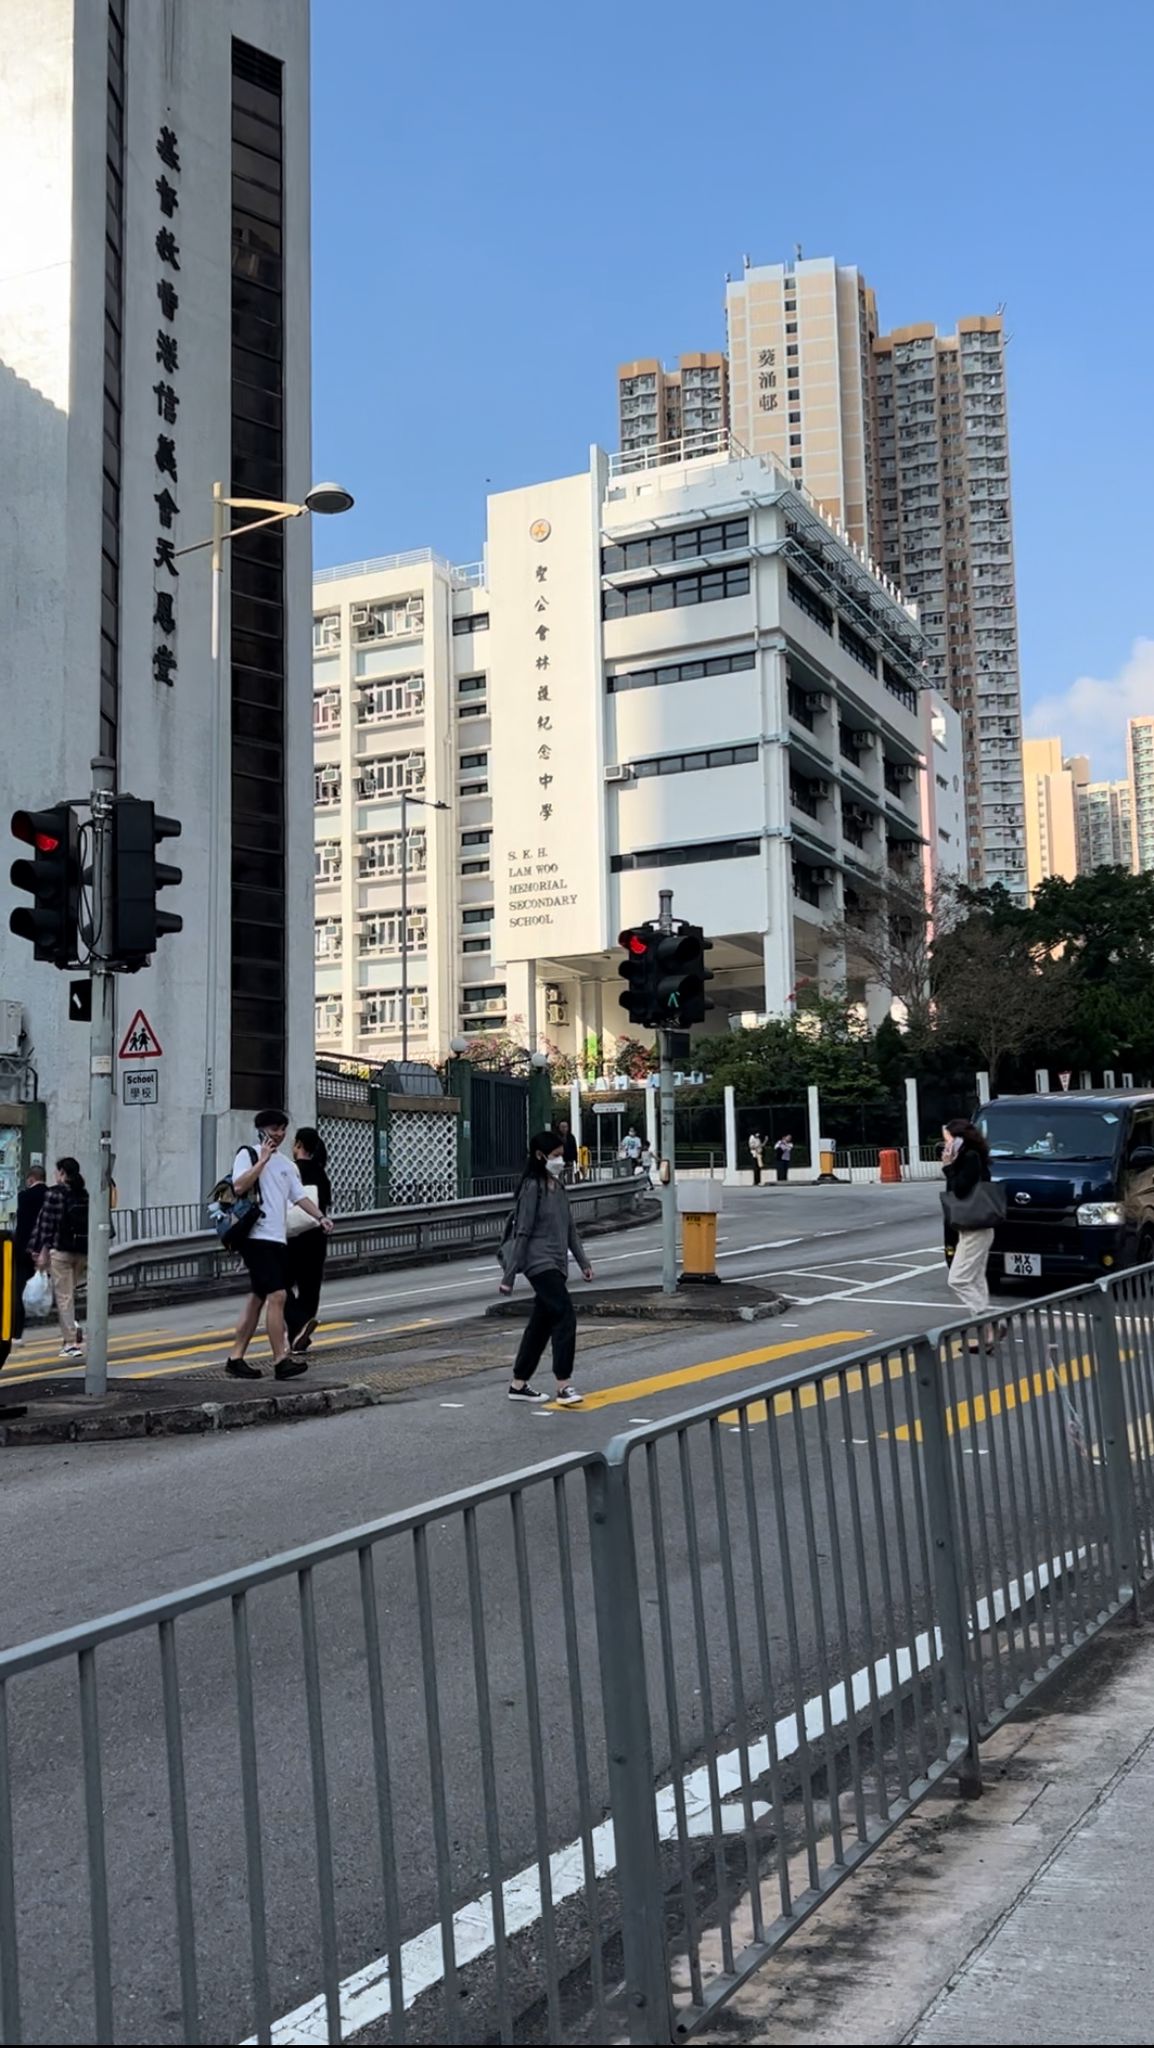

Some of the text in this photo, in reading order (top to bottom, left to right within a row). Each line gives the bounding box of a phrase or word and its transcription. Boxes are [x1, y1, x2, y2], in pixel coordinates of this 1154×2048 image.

[758, 348, 778, 411] 葵涌邨
[153, 125, 181, 687] 基督教香港信義會天恩堂
[534, 565, 553, 821] 聖公會林護紀念中學
[509, 863, 558, 877] LAM WOO
[509, 879, 568, 894] MEMORIAL
[509, 894, 578, 911] SECONDARY
[509, 914, 553, 928] SCHOOL
[127, 1074, 154, 1084] School
[130, 1087, 152, 1098] 學校
[1014, 1254, 1031, 1264] MX
[1014, 1265, 1033, 1275] 419
